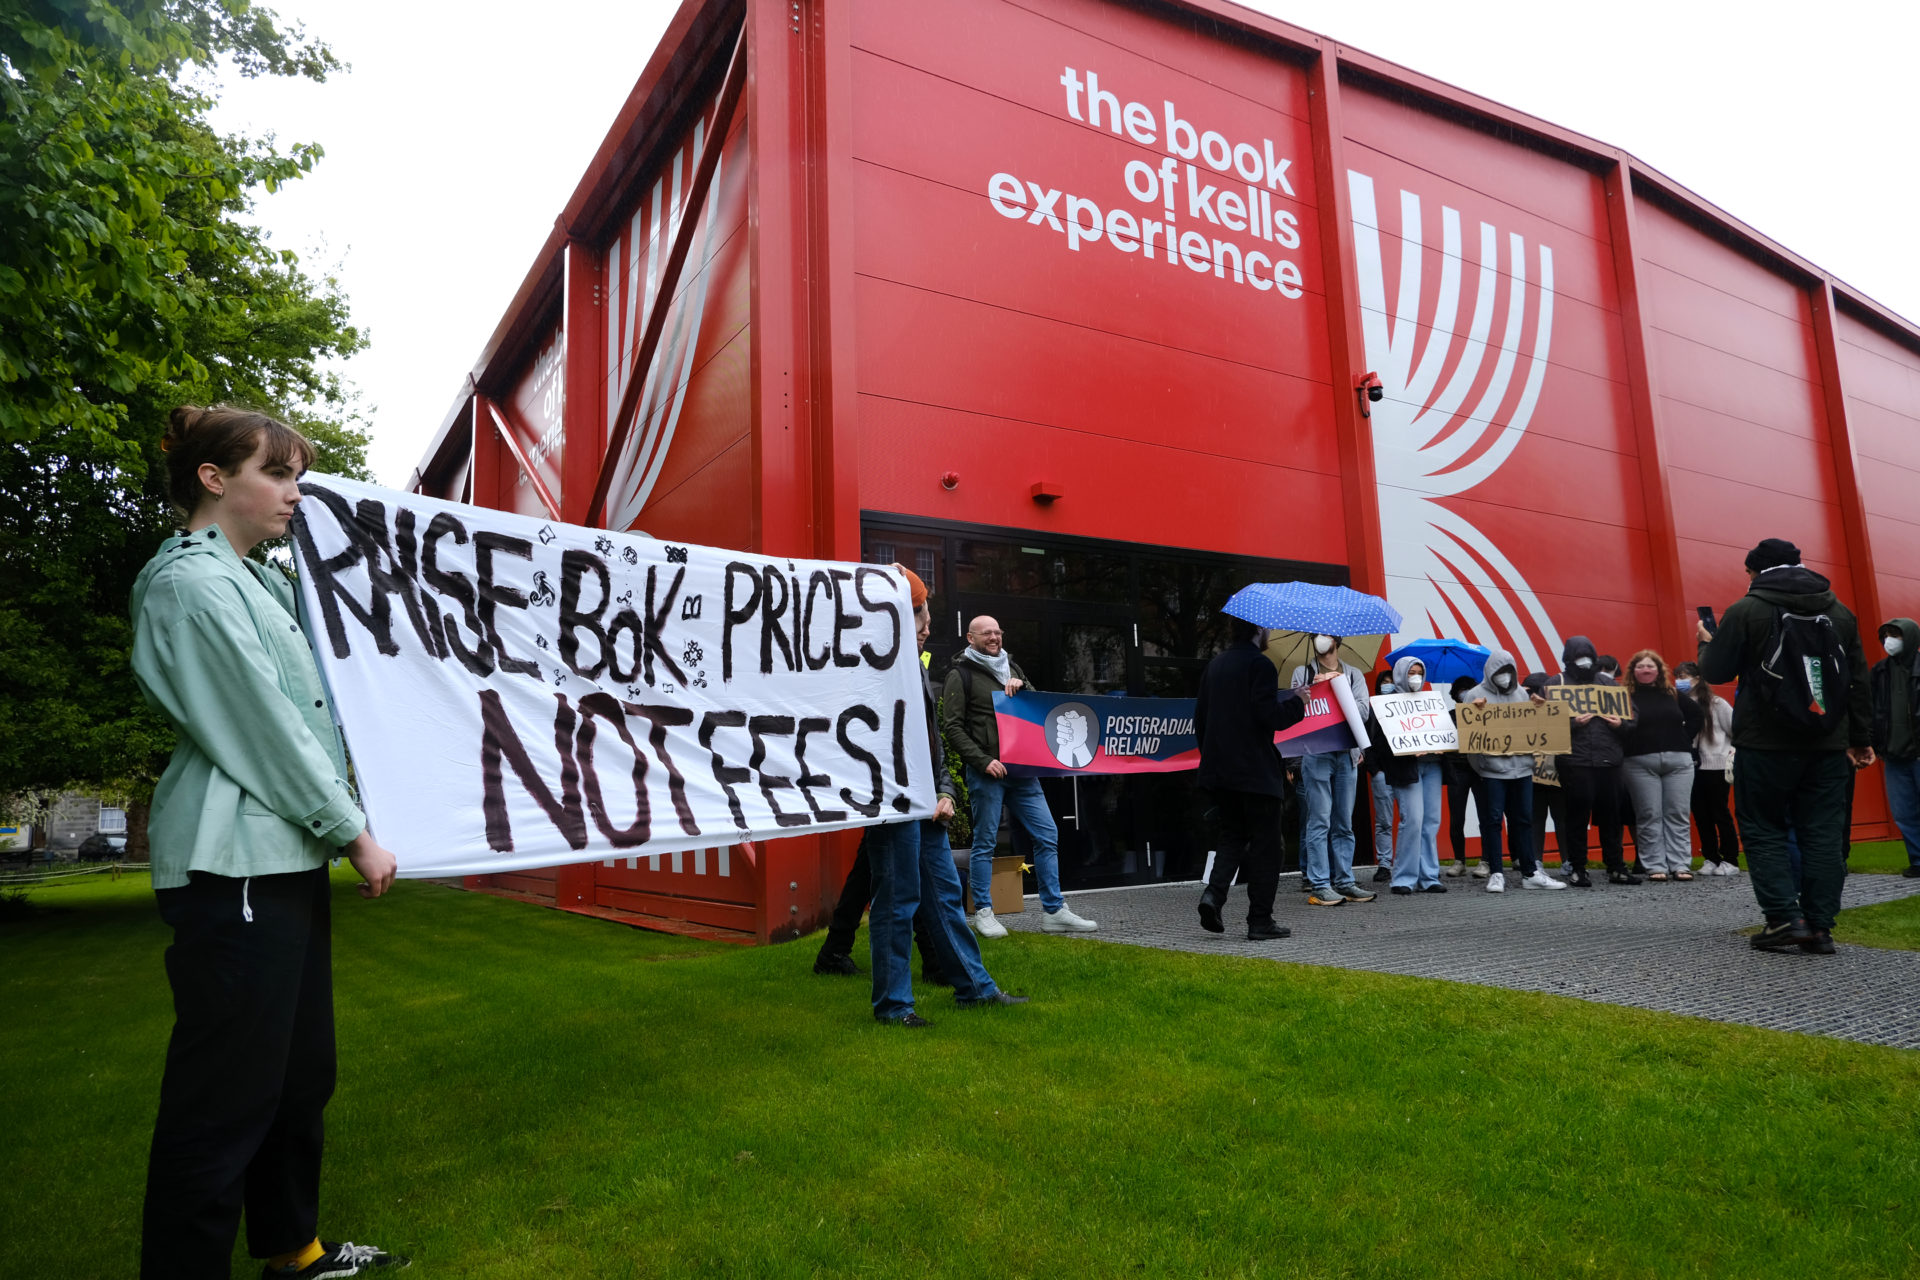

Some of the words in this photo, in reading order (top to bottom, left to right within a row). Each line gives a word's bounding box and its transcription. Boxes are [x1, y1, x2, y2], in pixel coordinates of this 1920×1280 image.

[1060, 66, 1157, 145] the
[1164, 100, 1295, 196] book
[1124, 157, 1178, 211] of
[1186, 164, 1300, 249] kells
[988, 172, 1303, 299] experience
[289, 482, 545, 682] RAISE
[1304, 697, 1331, 717] ION
[1384, 699, 1445, 717] STUDENTS
[1549, 688, 1597, 714] FREE
[1597, 690, 1629, 716] UNI
[1105, 716, 1196, 736] POSTGRADUA
[1400, 714, 1438, 732] NOT
[1461, 705, 1537, 726] Capitalism
[1547, 704, 1560, 716] is
[1104, 737, 1160, 755] IRELAND
[1392, 736, 1420, 749] CASH
[1424, 732, 1456, 746] COWS
[477, 689, 702, 853] NOT
[699, 699, 911, 829] FEES!
